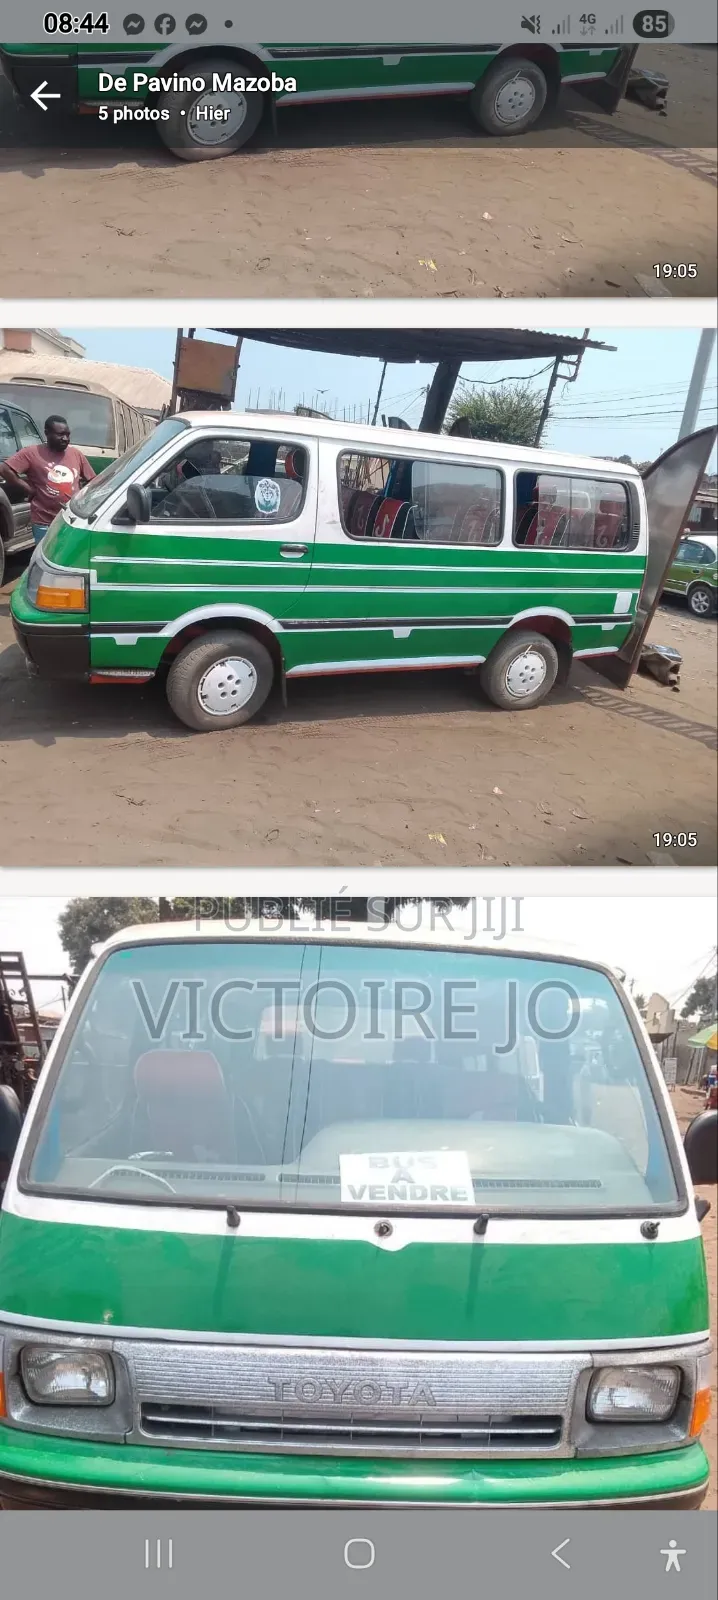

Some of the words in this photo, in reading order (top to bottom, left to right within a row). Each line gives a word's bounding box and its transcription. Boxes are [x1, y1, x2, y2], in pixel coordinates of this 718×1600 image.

[368, 1155, 438, 1169] BUS
[347, 1184, 469, 1202] VENDRE
[267, 1376, 437, 1407] TOYOTA
